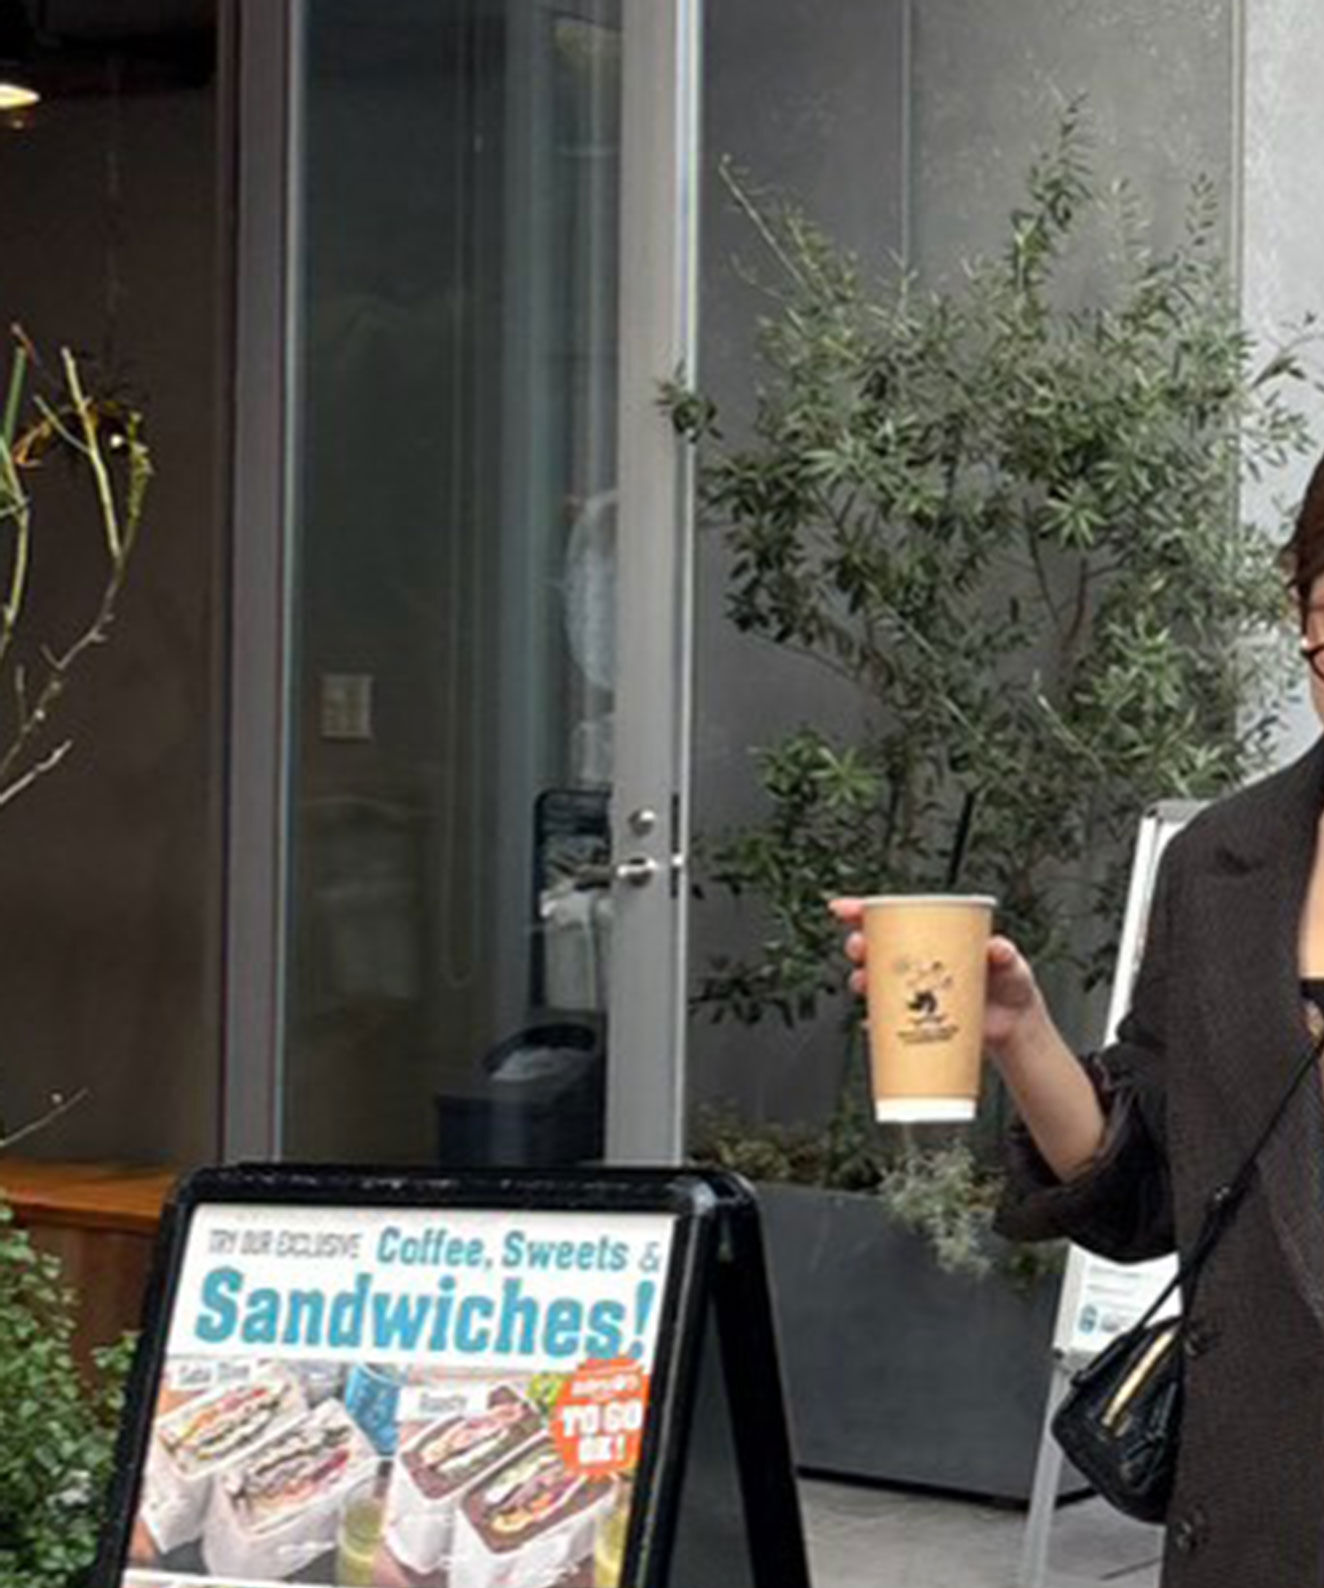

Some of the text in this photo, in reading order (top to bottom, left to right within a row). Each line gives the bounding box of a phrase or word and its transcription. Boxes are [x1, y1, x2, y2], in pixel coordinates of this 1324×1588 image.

[376, 1226, 495, 1271] Coffee,
[502, 1230, 629, 1271] Sweets
[639, 1241, 660, 1272] &
[193, 1266, 656, 1360] Sandwiches!
[562, 1403, 600, 1437] TO
